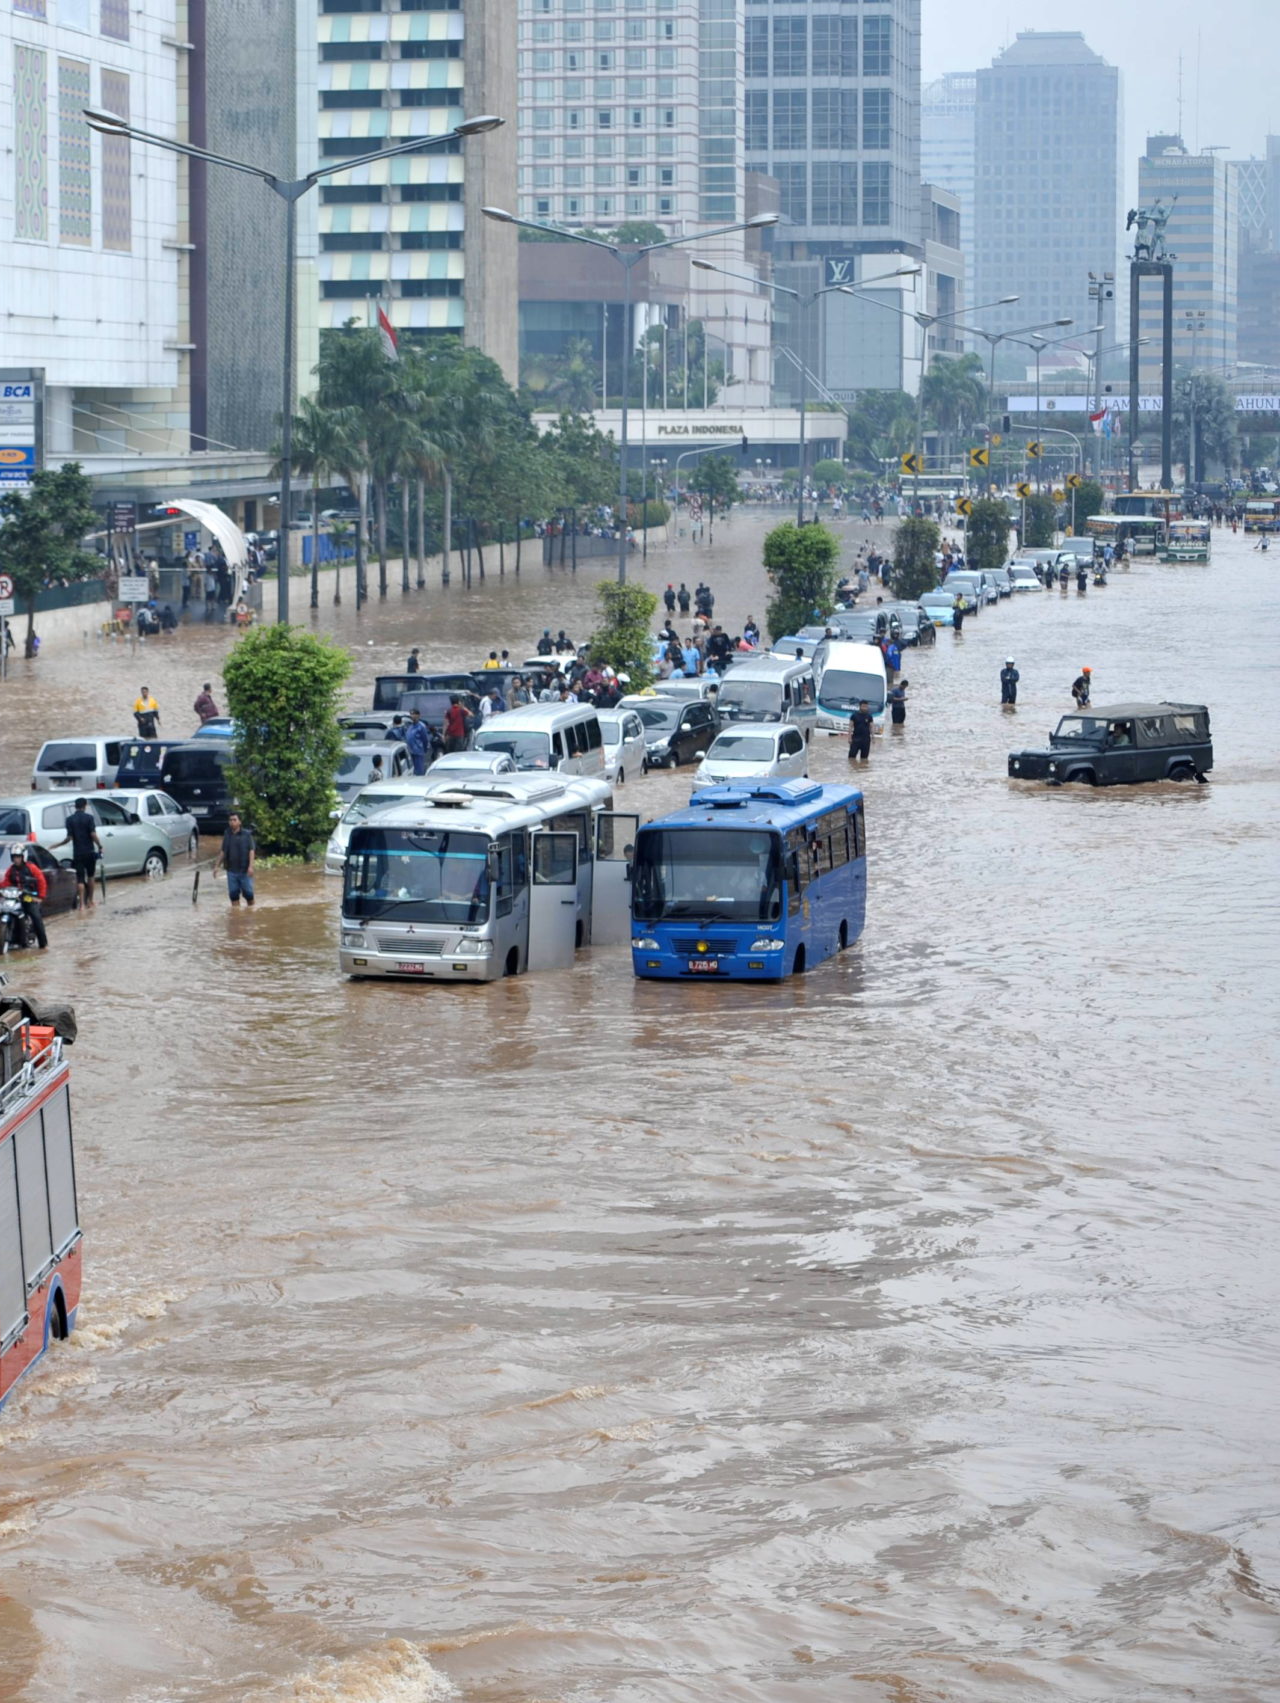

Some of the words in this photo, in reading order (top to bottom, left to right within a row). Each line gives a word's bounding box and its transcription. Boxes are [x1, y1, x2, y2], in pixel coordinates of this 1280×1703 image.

[3, 385, 31, 398] BCA
[1235, 398, 1274, 409] AHUN
[658, 426, 689, 435] PLAZA
[691, 425, 744, 434] INDONESIA
